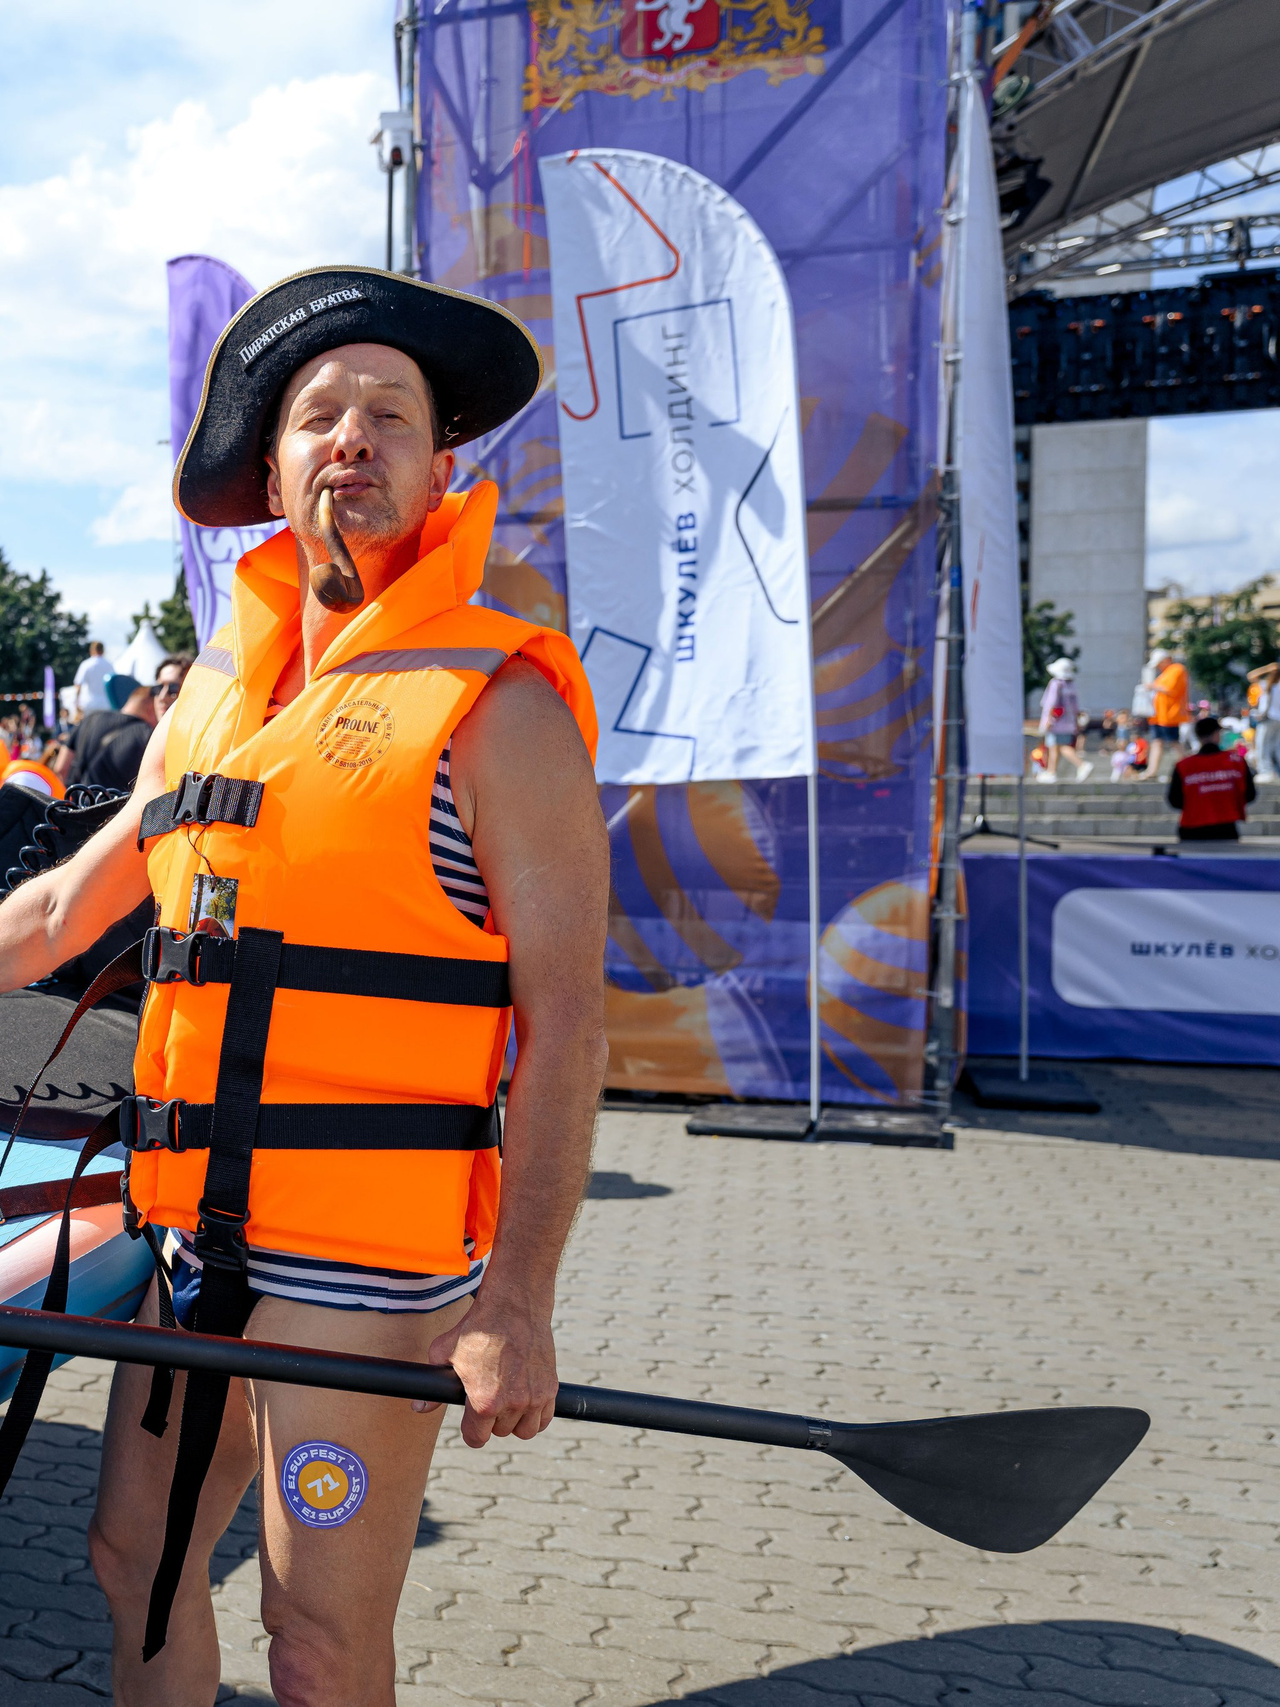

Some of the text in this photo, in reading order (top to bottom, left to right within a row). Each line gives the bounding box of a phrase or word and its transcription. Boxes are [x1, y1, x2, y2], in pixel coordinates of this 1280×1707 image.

[239, 288, 362, 364] ПИРАТСКАЯ БРАТВА
[661, 326, 698, 662] ШКУЛЁВ ХОЛДИНГ
[335, 716, 380, 734] PROLINE
[1131, 940, 1234, 958] ШКУЛЁВ
[288, 1448, 346, 1489] E1 SUP FEST
[301, 1477, 360, 1521] E1 SUP FEST
